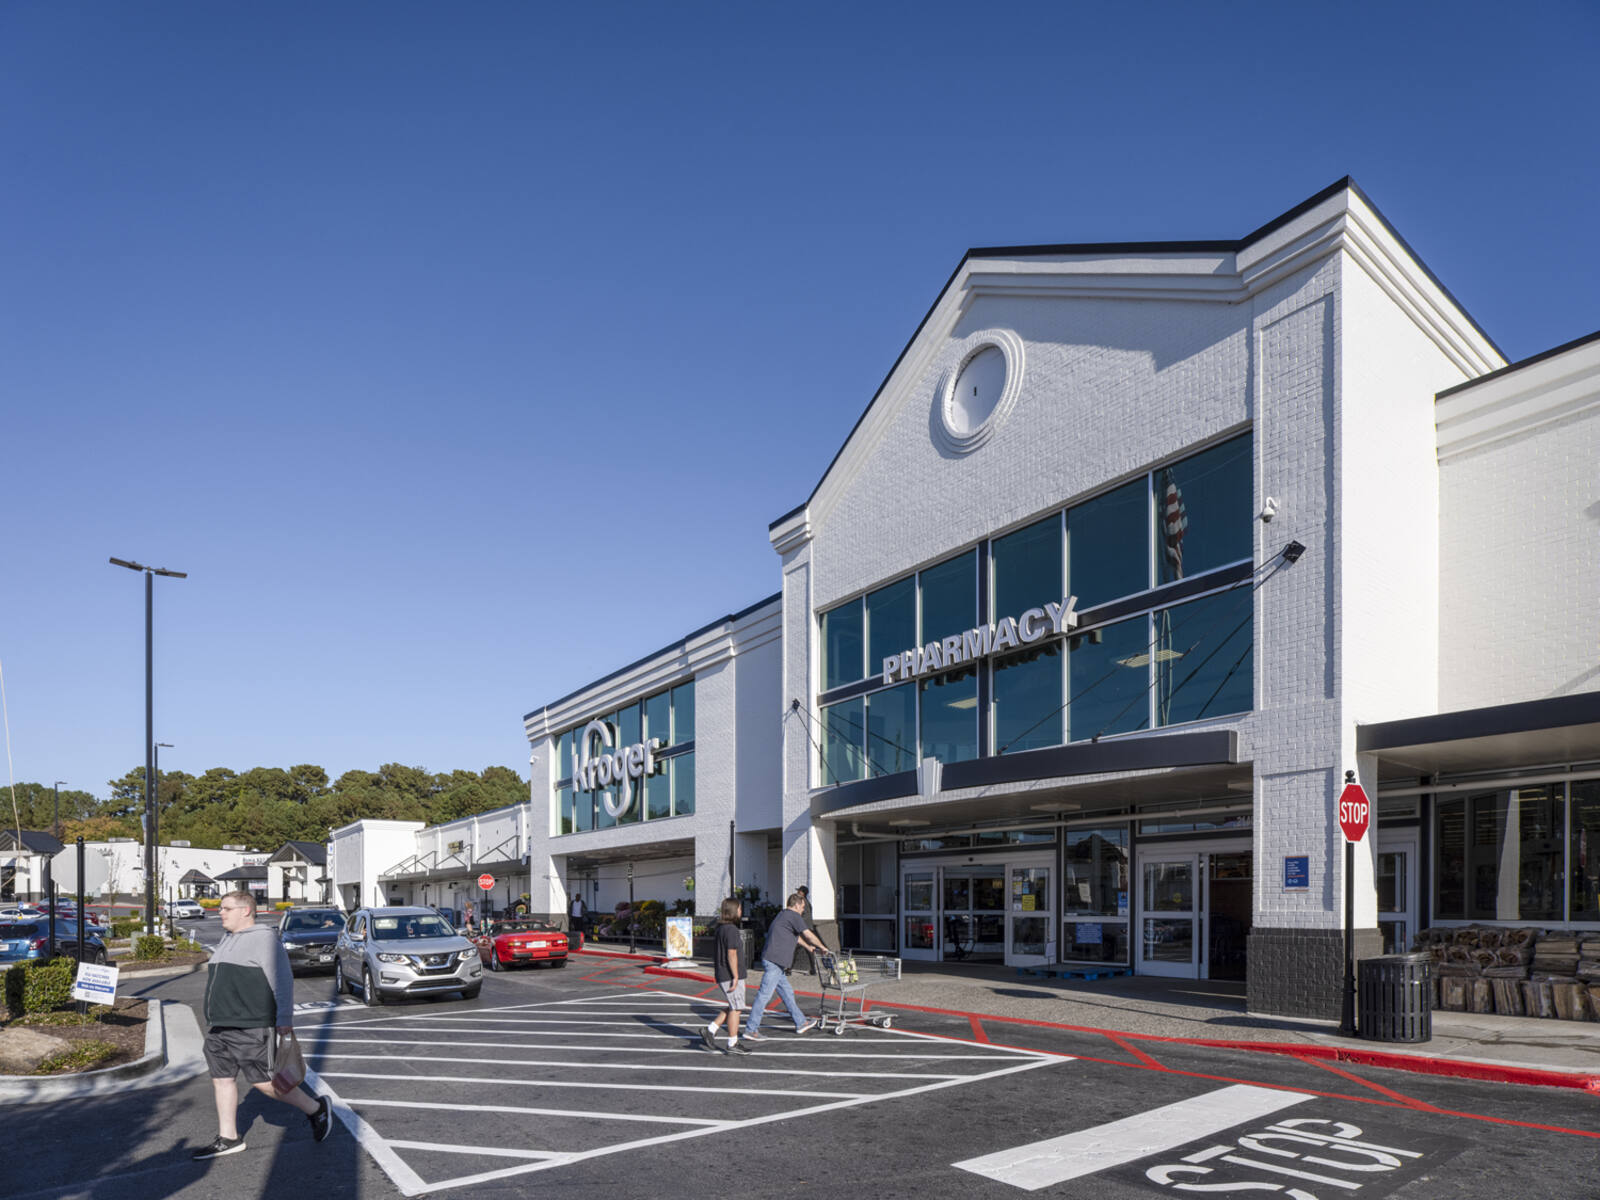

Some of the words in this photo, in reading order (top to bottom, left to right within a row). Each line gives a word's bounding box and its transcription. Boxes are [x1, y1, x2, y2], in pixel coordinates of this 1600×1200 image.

[883, 595, 1078, 685] PHARMACY
[571, 719, 660, 817] Kroger
[1340, 801, 1368, 824] STOP
[1146, 1118, 1424, 1200] STOP
